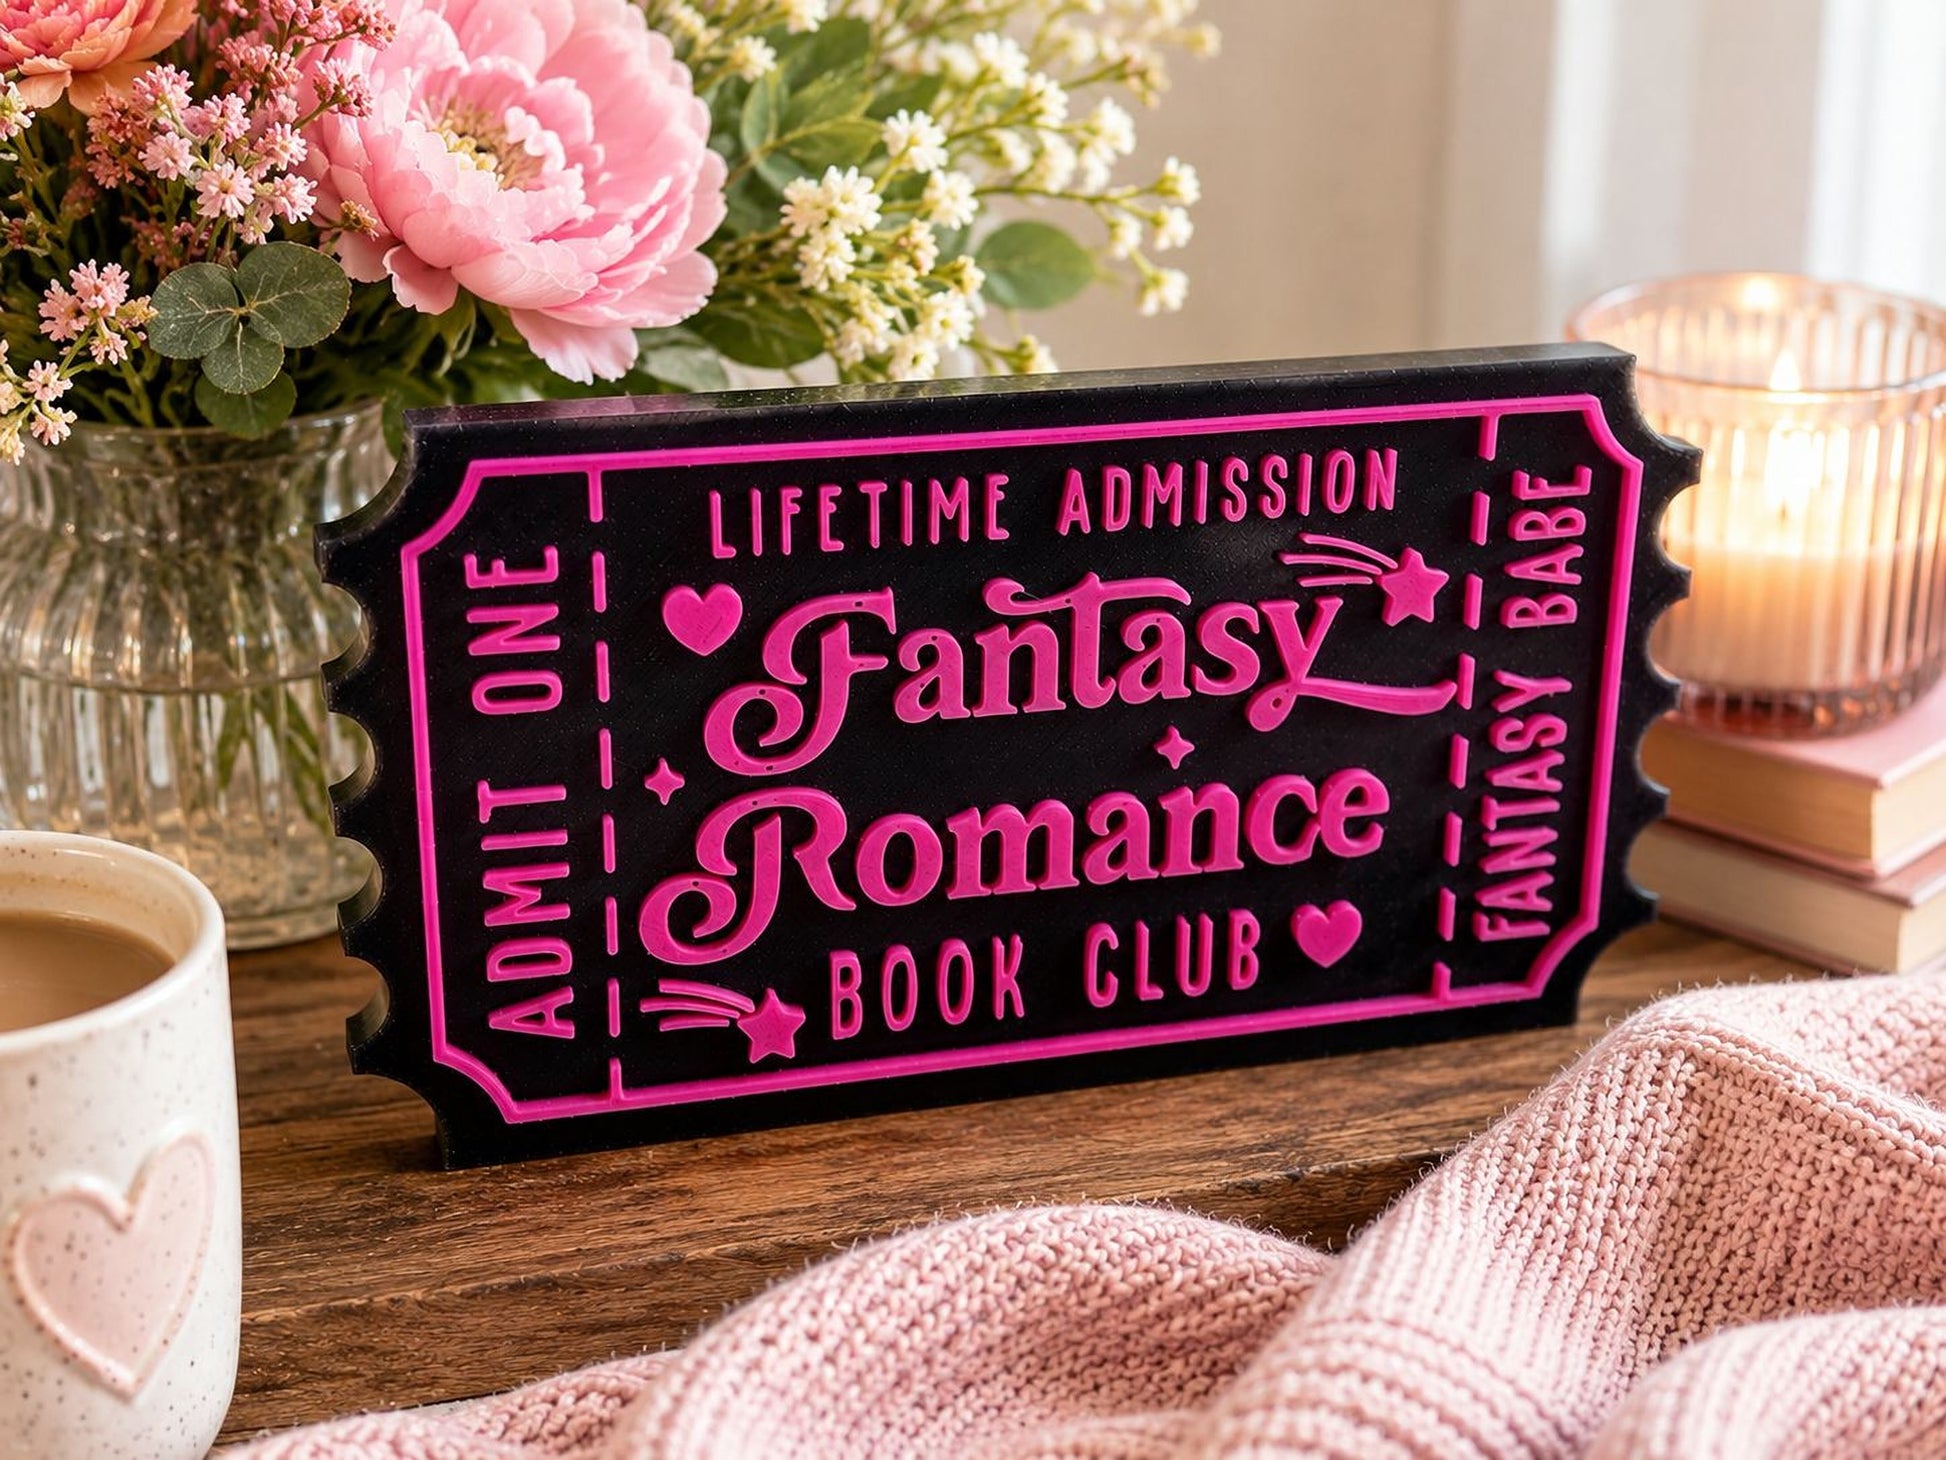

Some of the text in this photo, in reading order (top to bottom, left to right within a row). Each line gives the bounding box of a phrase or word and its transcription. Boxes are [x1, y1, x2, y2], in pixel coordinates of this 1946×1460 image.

[709, 447, 1398, 560] LIFETIME ADMISSION
[703, 571, 1459, 777] Fantasy
[1473, 464, 1593, 943] FANTASY BABE
[463, 545, 576, 1040] ADMIT ONE
[638, 767, 1391, 966] Romance
[829, 908, 1261, 1041] BOOK CLUB
